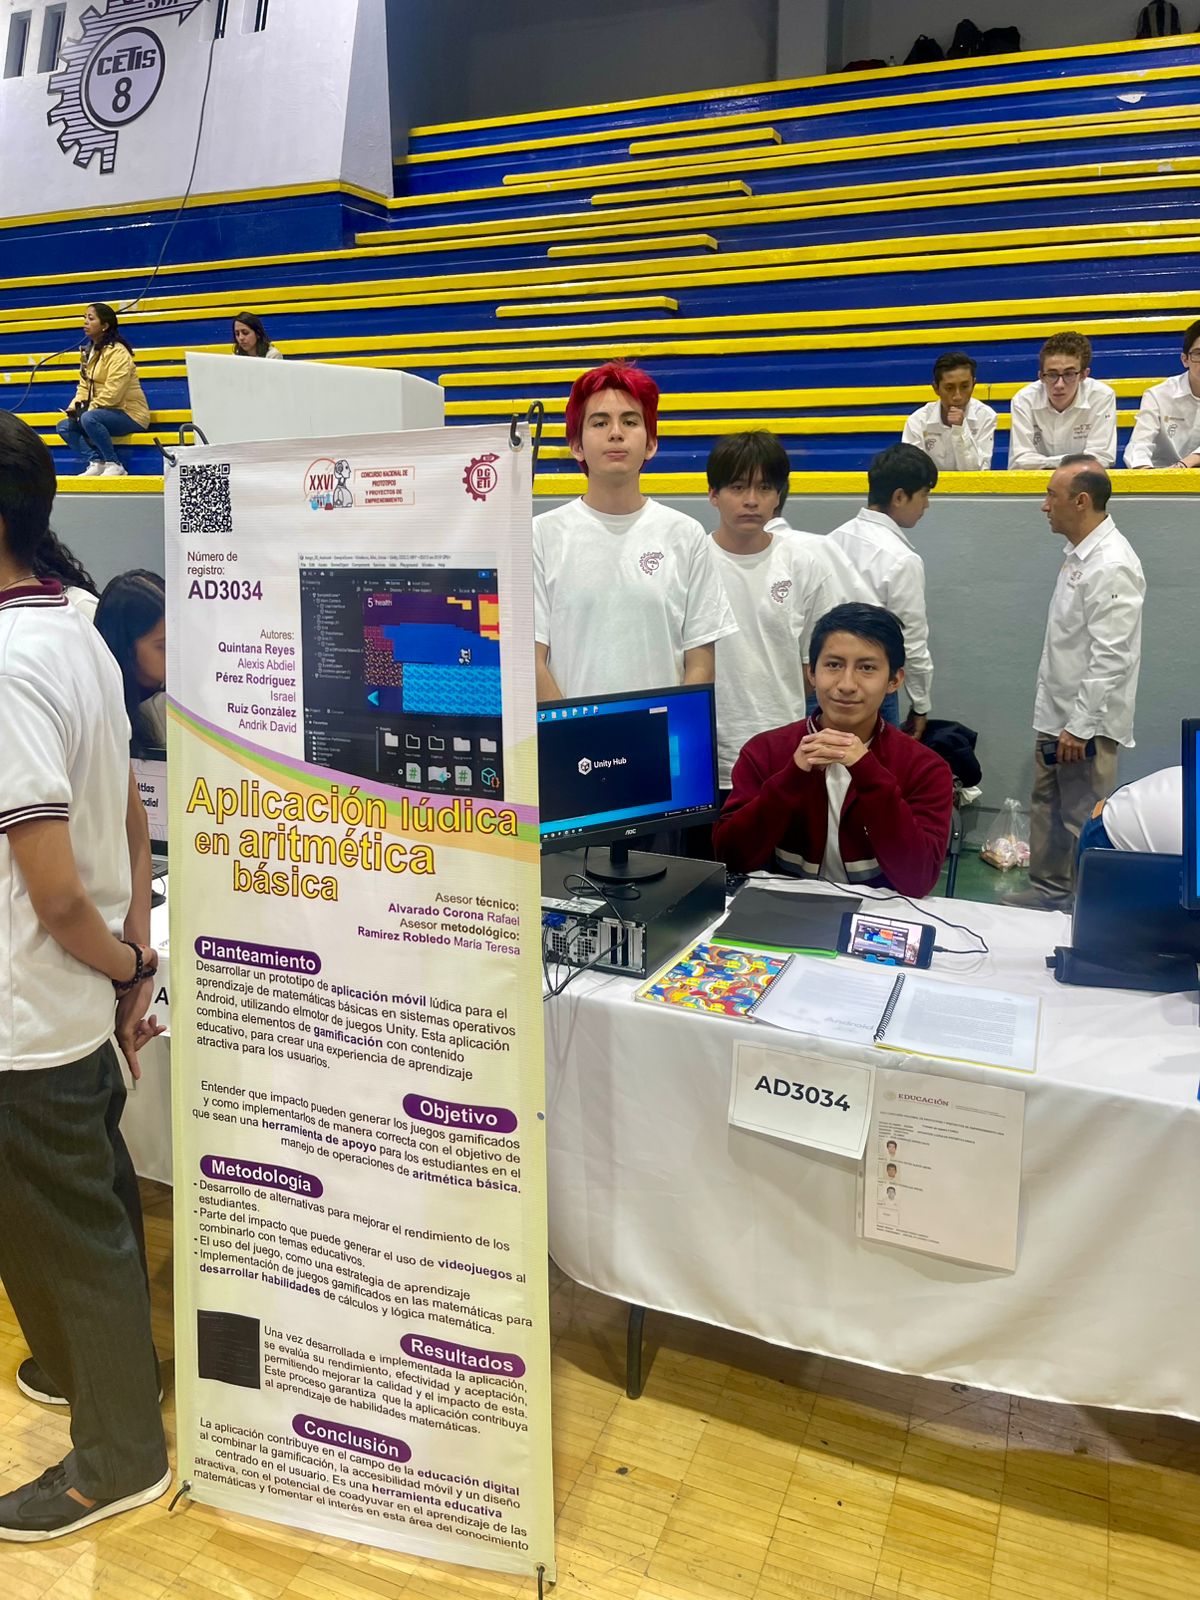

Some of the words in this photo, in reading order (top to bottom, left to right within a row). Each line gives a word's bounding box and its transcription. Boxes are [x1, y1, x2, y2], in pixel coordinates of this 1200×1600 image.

[112, 77, 132, 113] 8
[310, 474, 334, 490] XXVI
[188, 551, 224, 561] Número
[226, 551, 238, 561] de
[188, 565, 225, 577] registro:
[188, 580, 263, 600] AD3034
[368, 598, 373, 607] 5
[218, 642, 262, 654] Quintana
[265, 644, 295, 657] Reyes
[260, 629, 294, 640] Autores:
[216, 672, 243, 683] Pérez
[237, 658, 264, 669] Alexis
[267, 660, 295, 671] Abdiel
[227, 703, 248, 714] Ruiz
[251, 704, 297, 717] González
[271, 691, 296, 702] Israel
[239, 719, 267, 730] Andrik
[270, 721, 297, 733] David
[594, 760, 611, 768] Unity
[613, 757, 626, 765] Hub
[186, 777, 387, 829] Aplicación
[401, 796, 519, 836] lúdica
[195, 831, 229, 855] en
[239, 822, 436, 875] aritmética
[233, 860, 338, 902] básica
[388, 902, 439, 916] Alvarado
[442, 906, 484, 921] Corona
[487, 911, 519, 926] Rafael
[434, 892, 473, 904] Asesor
[475, 896, 519, 911] técnico:
[399, 918, 438, 929] Asesor
[440, 922, 519, 940] metodológico:
[402, 931, 451, 945] Robledo
[484, 940, 520, 955] Teresa
[201, 940, 317, 972] Planteamiento
[195, 960, 251, 977] Desarrollar
[253, 971, 266, 980] un
[268, 973, 315, 988] prototipo
[316, 978, 328, 991] de
[331, 984, 388, 1002] aplicación
[391, 993, 426, 1006] móvil
[429, 996, 462, 1013] lúdica
[465, 1006, 492, 1017] para
[496, 1007, 507, 1019] el
[195, 977, 254, 995] aprendizaje
[256, 984, 270, 996] de
[272, 989, 336, 1008] matemáticas
[337, 999, 378, 1016] básicas
[381, 1009, 396, 1018] en
[399, 1009, 450, 1027] sistemas
[452, 1020, 516, 1036] operativos
[195, 990, 237, 1007] Android,
[240, 998, 290, 1014] utilizando
[331, 1014, 343, 1026] de
[345, 1016, 382, 1033] juegos
[385, 1022, 418, 1039] Unity.
[421, 1027, 446, 1043] Esta
[448, 1035, 510, 1051] aplicación
[196, 1006, 239, 1021] combina
[241, 1012, 296, 1029] elementos
[298, 1020, 311, 1032] de
[313, 1026, 383, 1047] gamificación
[386, 1040, 407, 1051] con
[410, 1044, 464, 1062] contenido
[824, 1016, 874, 1030] Android
[754, 1075, 850, 1112] AD3034
[898, 1093, 949, 1106] EDUCACIÓN
[200, 1080, 246, 1096] Entender
[248, 1090, 267, 1100] que
[270, 1091, 309, 1108] impacto
[310, 1102, 346, 1118] pueden
[348, 1112, 391, 1125] generar
[393, 1117, 408, 1130] los
[409, 1121, 445, 1139] juegos
[448, 1132, 520, 1149] gamificados
[420, 1100, 499, 1128] Objetivo
[211, 1159, 312, 1193] Metodología
[280, 1137, 315, 1154] manejo
[316, 1146, 330, 1157] de
[332, 1151, 395, 1172] operaciones
[396, 1164, 410, 1176] de
[412, 1170, 473, 1187] aritmética
[476, 1177, 521, 1193] básica.
[199, 1179, 251, 1196] Desarrollo
[253, 1188, 267, 1199] de
[269, 1192, 325, 1213] alternativas
[327, 1207, 350, 1219] para
[352, 1213, 390, 1231] mejorar
[391, 1225, 401, 1234] el
[404, 1228, 472, 1244] rendimiento
[475, 1236, 490, 1247] de
[493, 1238, 510, 1251] los
[199, 1223, 255, 1238] combinarlo
[257, 1232, 276, 1242] con
[278, 1234, 308, 1251] temas
[310, 1244, 365, 1267] educativos.
[199, 1262, 259, 1279] desarrollar
[261, 1271, 321, 1296] habilidades
[323, 1289, 336, 1300] de
[337, 1294, 378, 1313] cálculos
[381, 1307, 388, 1316] y
[391, 1306, 425, 1319] lógica
[428, 1312, 495, 1334] matemática.
[264, 1325, 283, 1339] Una
[285, 1333, 303, 1344] vez
[305, 1337, 365, 1360] desarrollada
[379, 1354, 452, 1378] implementada
[455, 1369, 465, 1381] la
[468, 1370, 527, 1393] aplicación,
[411, 1338, 514, 1373] Resultados
[264, 1364, 286, 1377] Este
[289, 1372, 327, 1389] proceso
[328, 1383, 376, 1399] garantiza
[382, 1394, 401, 1405] que
[403, 1397, 412, 1408] la
[415, 1403, 469, 1420] aplicación
[471, 1413, 528, 1432] contribuya
[304, 1420, 399, 1457] Conclusión
[199, 1417, 211, 1428] La
[214, 1423, 264, 1440] aplicación
[266, 1434, 319, 1453] contribuye
[321, 1447, 334, 1457] en
[337, 1450, 346, 1460] el
[349, 1450, 385, 1469] campo
[387, 1462, 401, 1473] de
[403, 1465, 414, 1475] la
[417, 1469, 479, 1486] educación
[482, 1479, 519, 1496] digital
